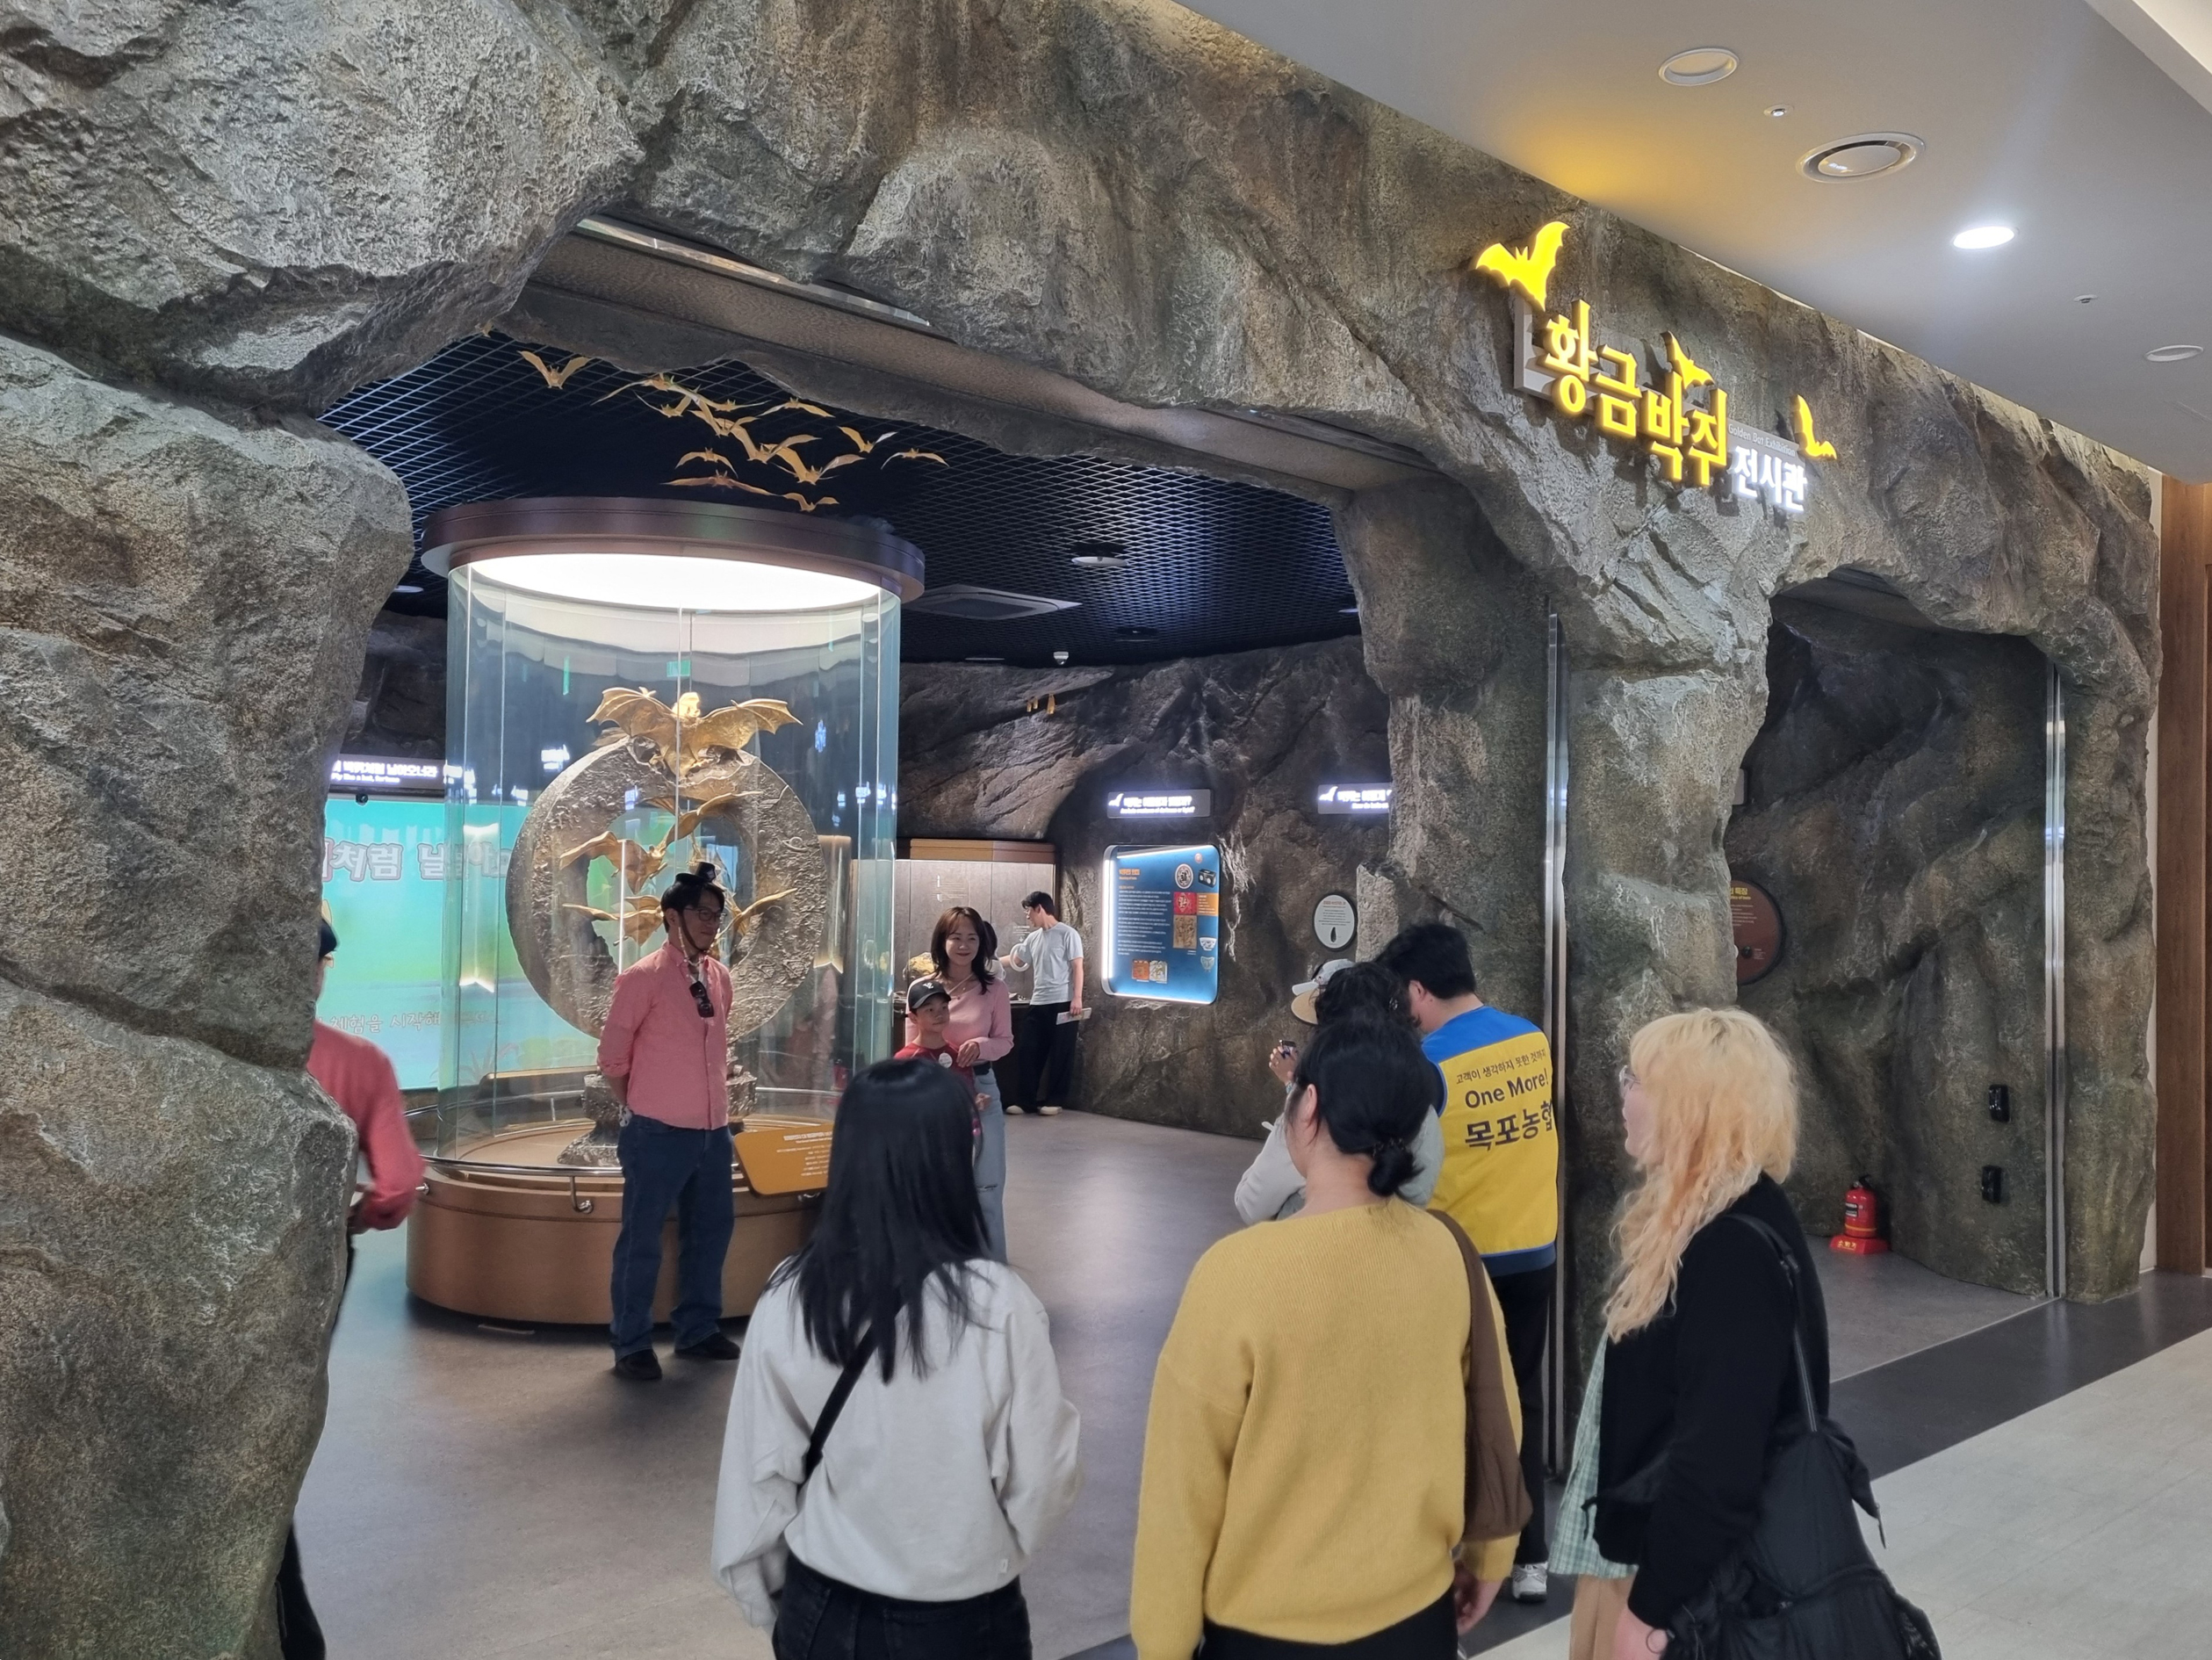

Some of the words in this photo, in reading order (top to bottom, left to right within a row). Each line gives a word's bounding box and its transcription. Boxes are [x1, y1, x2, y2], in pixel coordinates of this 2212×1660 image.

[1545, 299, 1728, 487] 황금박쥐
[1728, 423, 1751, 441] Golden
[1753, 432, 1764, 445] Bat
[1765, 437, 1796, 458] Exhibition
[1733, 445, 1808, 512] 전시관
[1456, 1069, 1481, 1084] 고객이
[1482, 1059, 1515, 1078] 생각하지
[1515, 1054, 1530, 1068] 못한
[1465, 1087, 1505, 1108] One
[1507, 1067, 1549, 1098] More!
[1465, 1098, 1553, 1151] 목포농협
